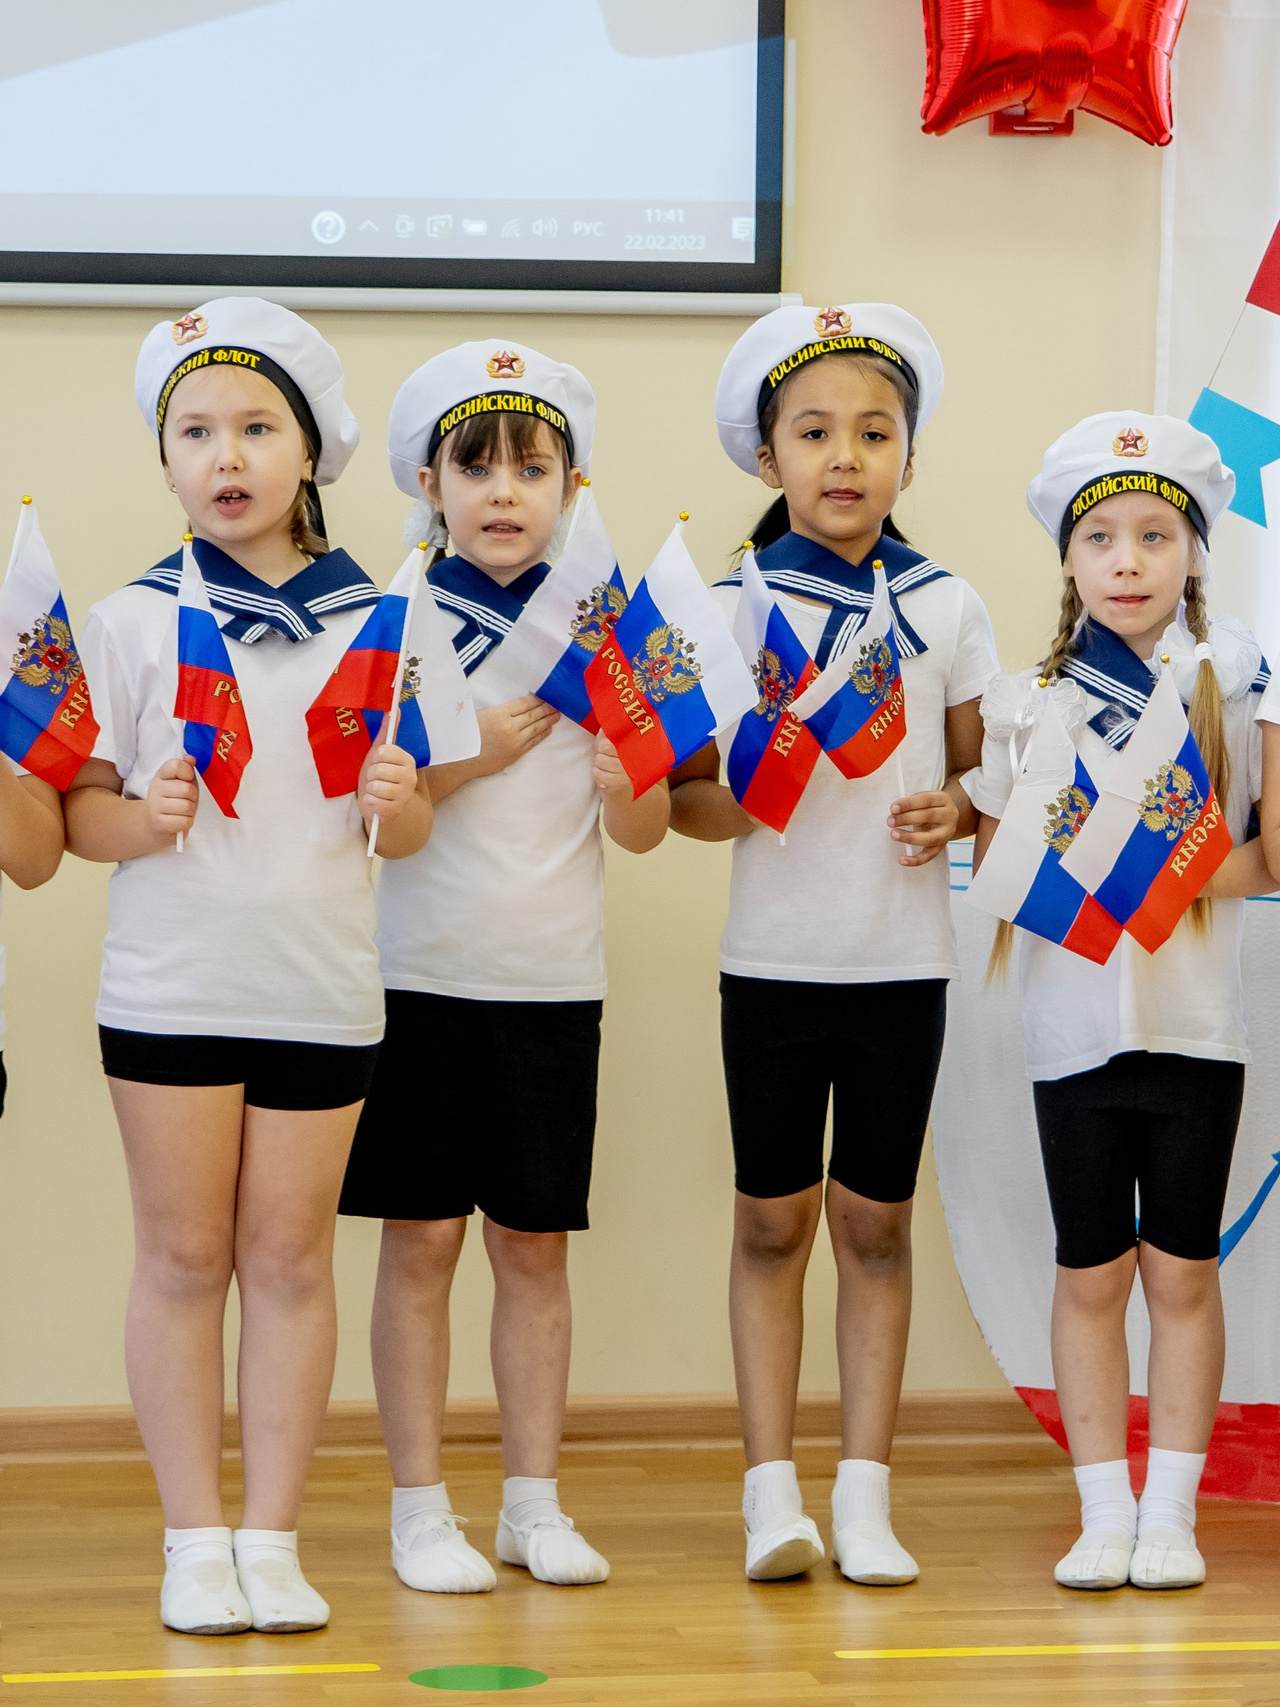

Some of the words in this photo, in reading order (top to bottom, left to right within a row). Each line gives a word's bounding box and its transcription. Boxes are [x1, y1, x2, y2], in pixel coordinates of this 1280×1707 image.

[645, 208, 685, 223] 11:41
[572, 221, 604, 237] РУС
[624, 235, 706, 250] 22.02.2023
[212, 349, 260, 368] ФЛОТ
[868, 338, 902, 365] ФЛОТ
[440, 393, 533, 436] РОССИЙСКИЙ
[535, 402, 566, 432] ФЛОТ
[1072, 473, 1157, 521] РОССИЙСКИЙ
[1159, 481, 1188, 512] ФЛОТ
[601, 646, 655, 735] РОССИЯ
